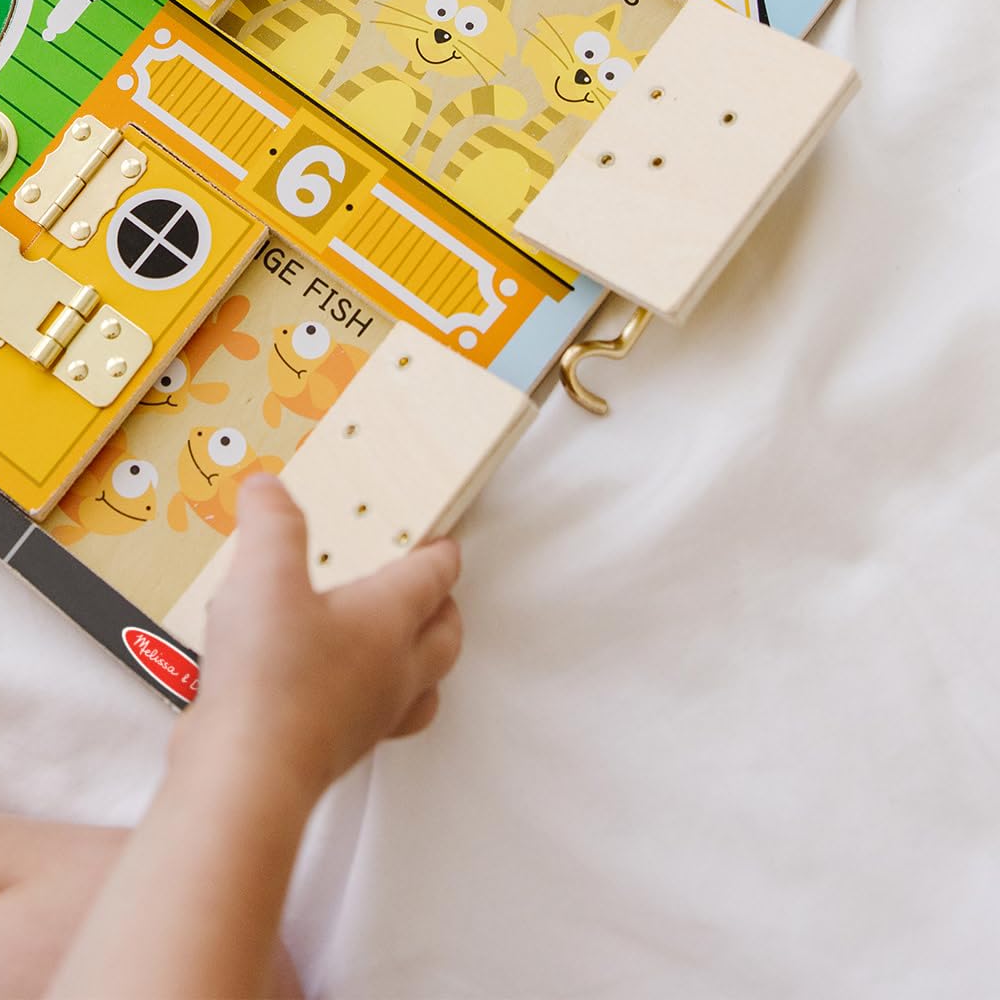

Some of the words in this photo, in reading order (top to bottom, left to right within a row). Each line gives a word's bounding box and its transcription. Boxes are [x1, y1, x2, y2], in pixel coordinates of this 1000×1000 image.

[276, 144, 346, 218] 6
[302, 276, 374, 338] FISH
[132, 634, 179, 676] Melissa
